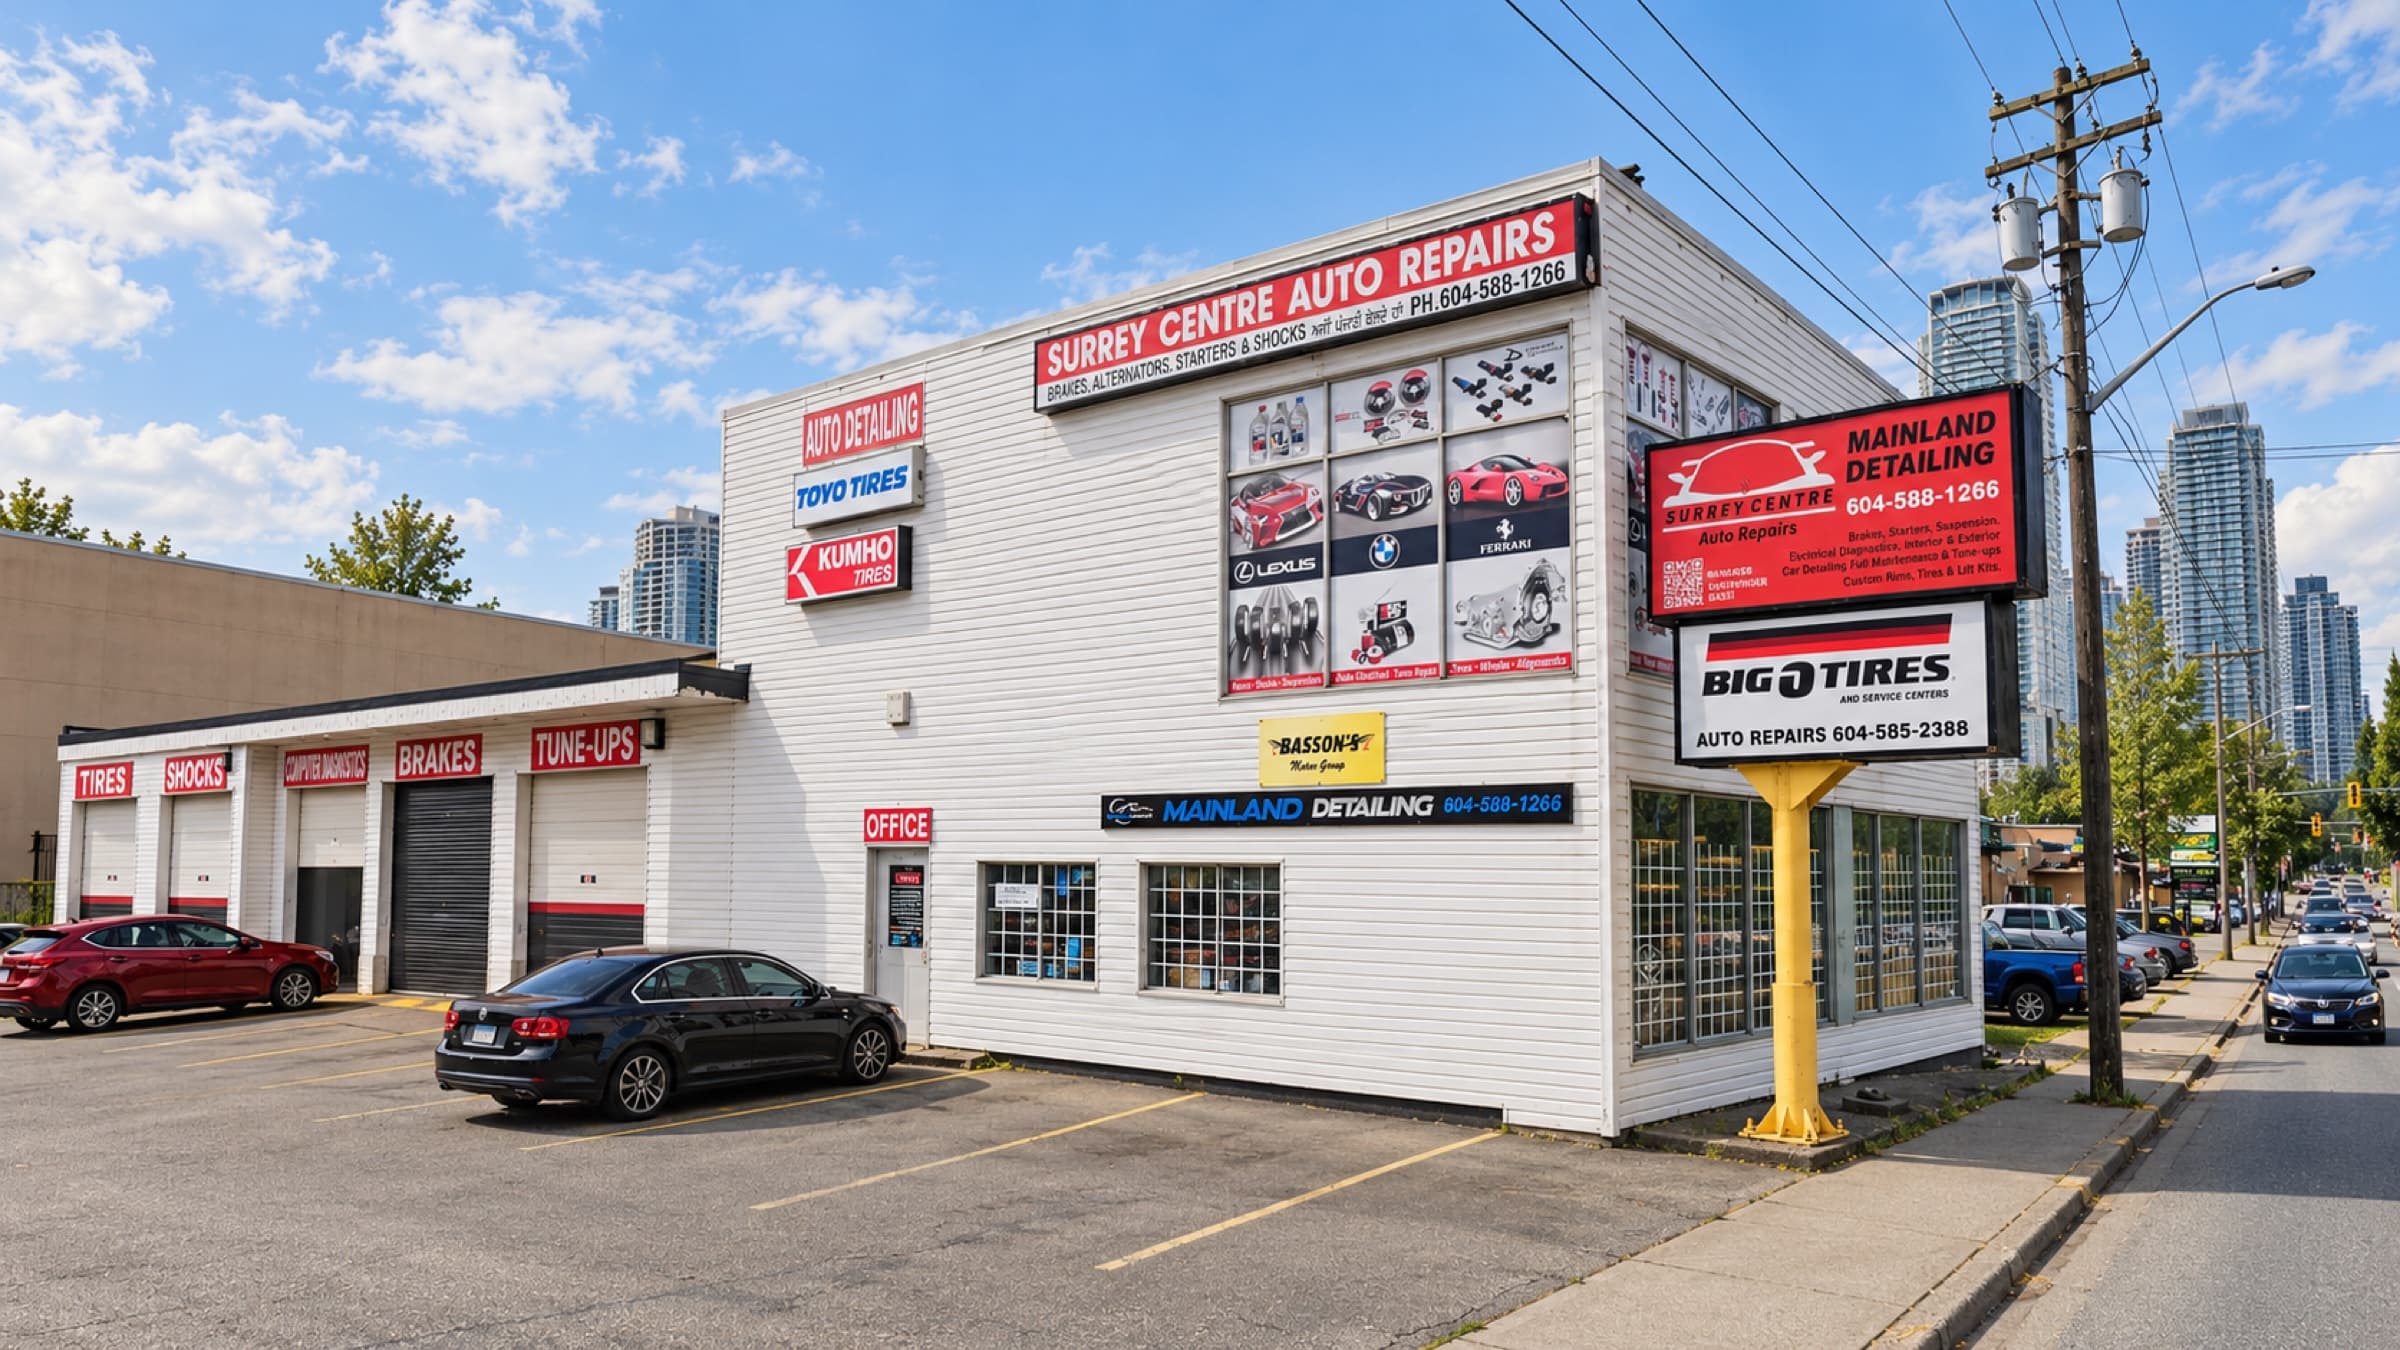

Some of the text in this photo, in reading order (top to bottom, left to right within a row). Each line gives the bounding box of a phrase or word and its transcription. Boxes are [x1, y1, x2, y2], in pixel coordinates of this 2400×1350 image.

[1048, 211, 1555, 377] SURREY CENTRE AUTO REPAIRS
[1410, 260, 1566, 316] PH.604-588-1266
[1176, 343, 1237, 370] STARTERS
[1241, 341, 1250, 355] &
[1254, 323, 1306, 351] SHOCKS
[805, 391, 919, 459] AUTO DETAILING
[1847, 410, 1997, 454] MAINLAND
[1846, 441, 1996, 483] DETAILING
[796, 465, 908, 509] TOYO TIRES
[1846, 480, 2000, 515] 604-588-1266
[1665, 488, 1835, 524] SURREY CENTRE
[1699, 521, 1798, 546] Auto Repairs
[818, 535, 894, 571] KUMHO
[1257, 557, 1317, 576] LEXUS
[1782, 566, 1800, 576] Car
[1803, 561, 1847, 575] Detailing
[854, 564, 892, 586] TIRES
[1917, 568, 1944, 579] Tires
[1702, 654, 1951, 699] BIG O TIRES
[1839, 689, 1949, 704] AND SERVICE CENTERS
[536, 726, 635, 766] TUNE-UPS
[1279, 733, 1360, 755] BASSON'S
[1696, 719, 1970, 748] AUTO REPAIRS 604-585-2388
[166, 755, 224, 790] SHOCKS
[399, 739, 476, 777] BRAKES
[1320, 758, 1345, 773] Group
[80, 767, 126, 796] TIRES
[866, 812, 928, 839] OFFICE
[1162, 794, 1562, 822] MAINLAND DETAILING 604-588-1266
